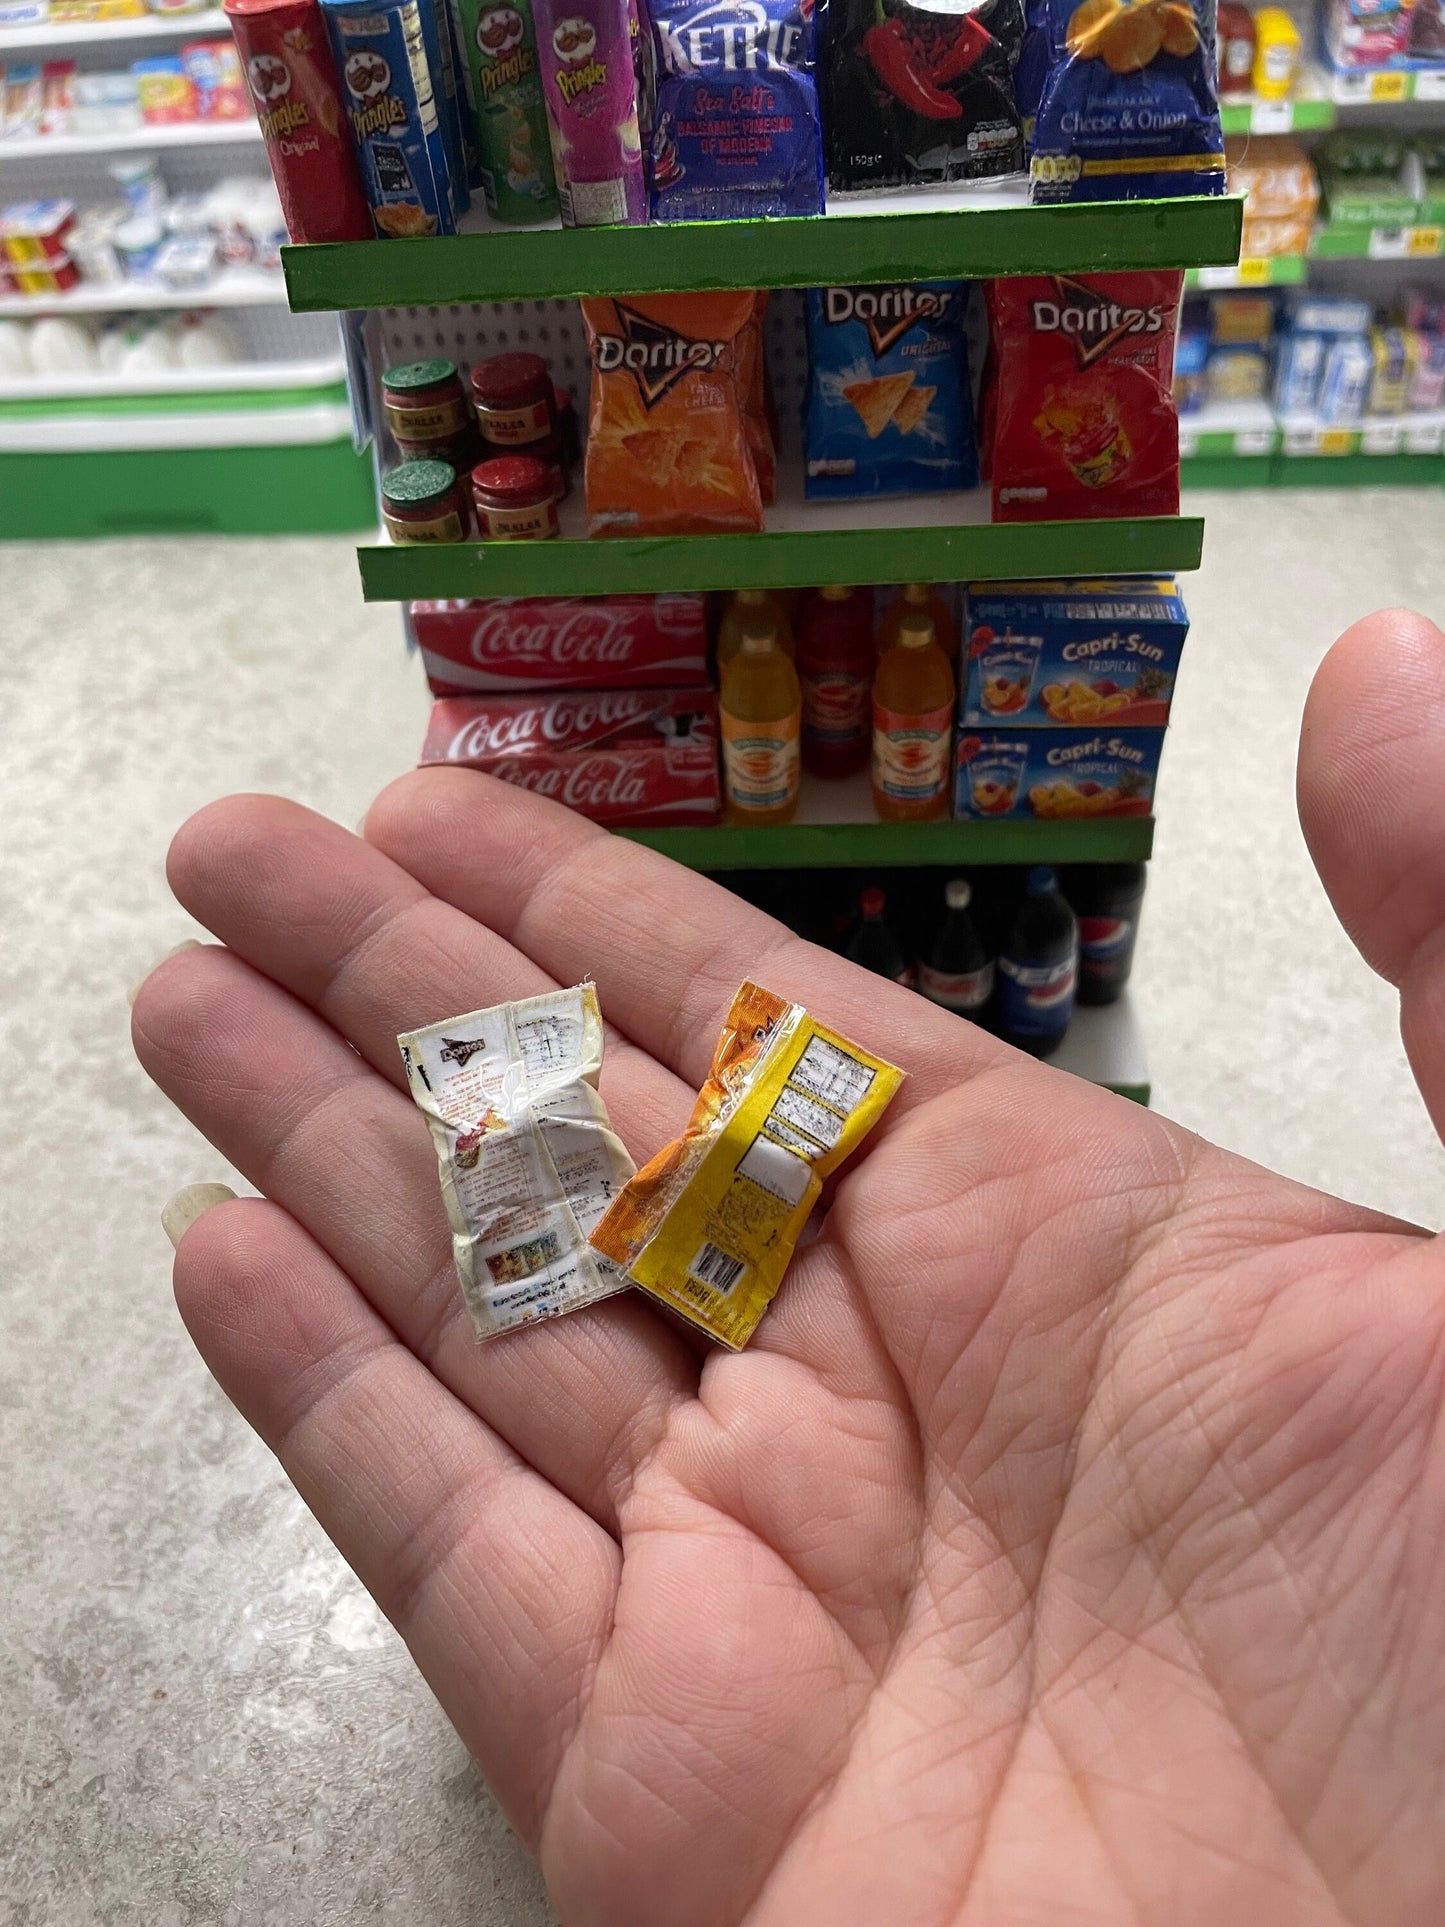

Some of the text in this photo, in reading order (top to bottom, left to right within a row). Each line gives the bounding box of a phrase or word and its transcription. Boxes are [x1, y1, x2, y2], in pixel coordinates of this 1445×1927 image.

[556, 57, 607, 106] Pringles
[353, 96, 406, 145] Pringles
[1060, 110, 1188, 133] Cheese & Onion
[1033, 301, 1162, 332] Doritos
[1061, 631, 1165, 662] Capri-Sun
[1088, 659, 1138, 673] TROPICAL
[1046, 737, 1144, 765] Capri-Sun
